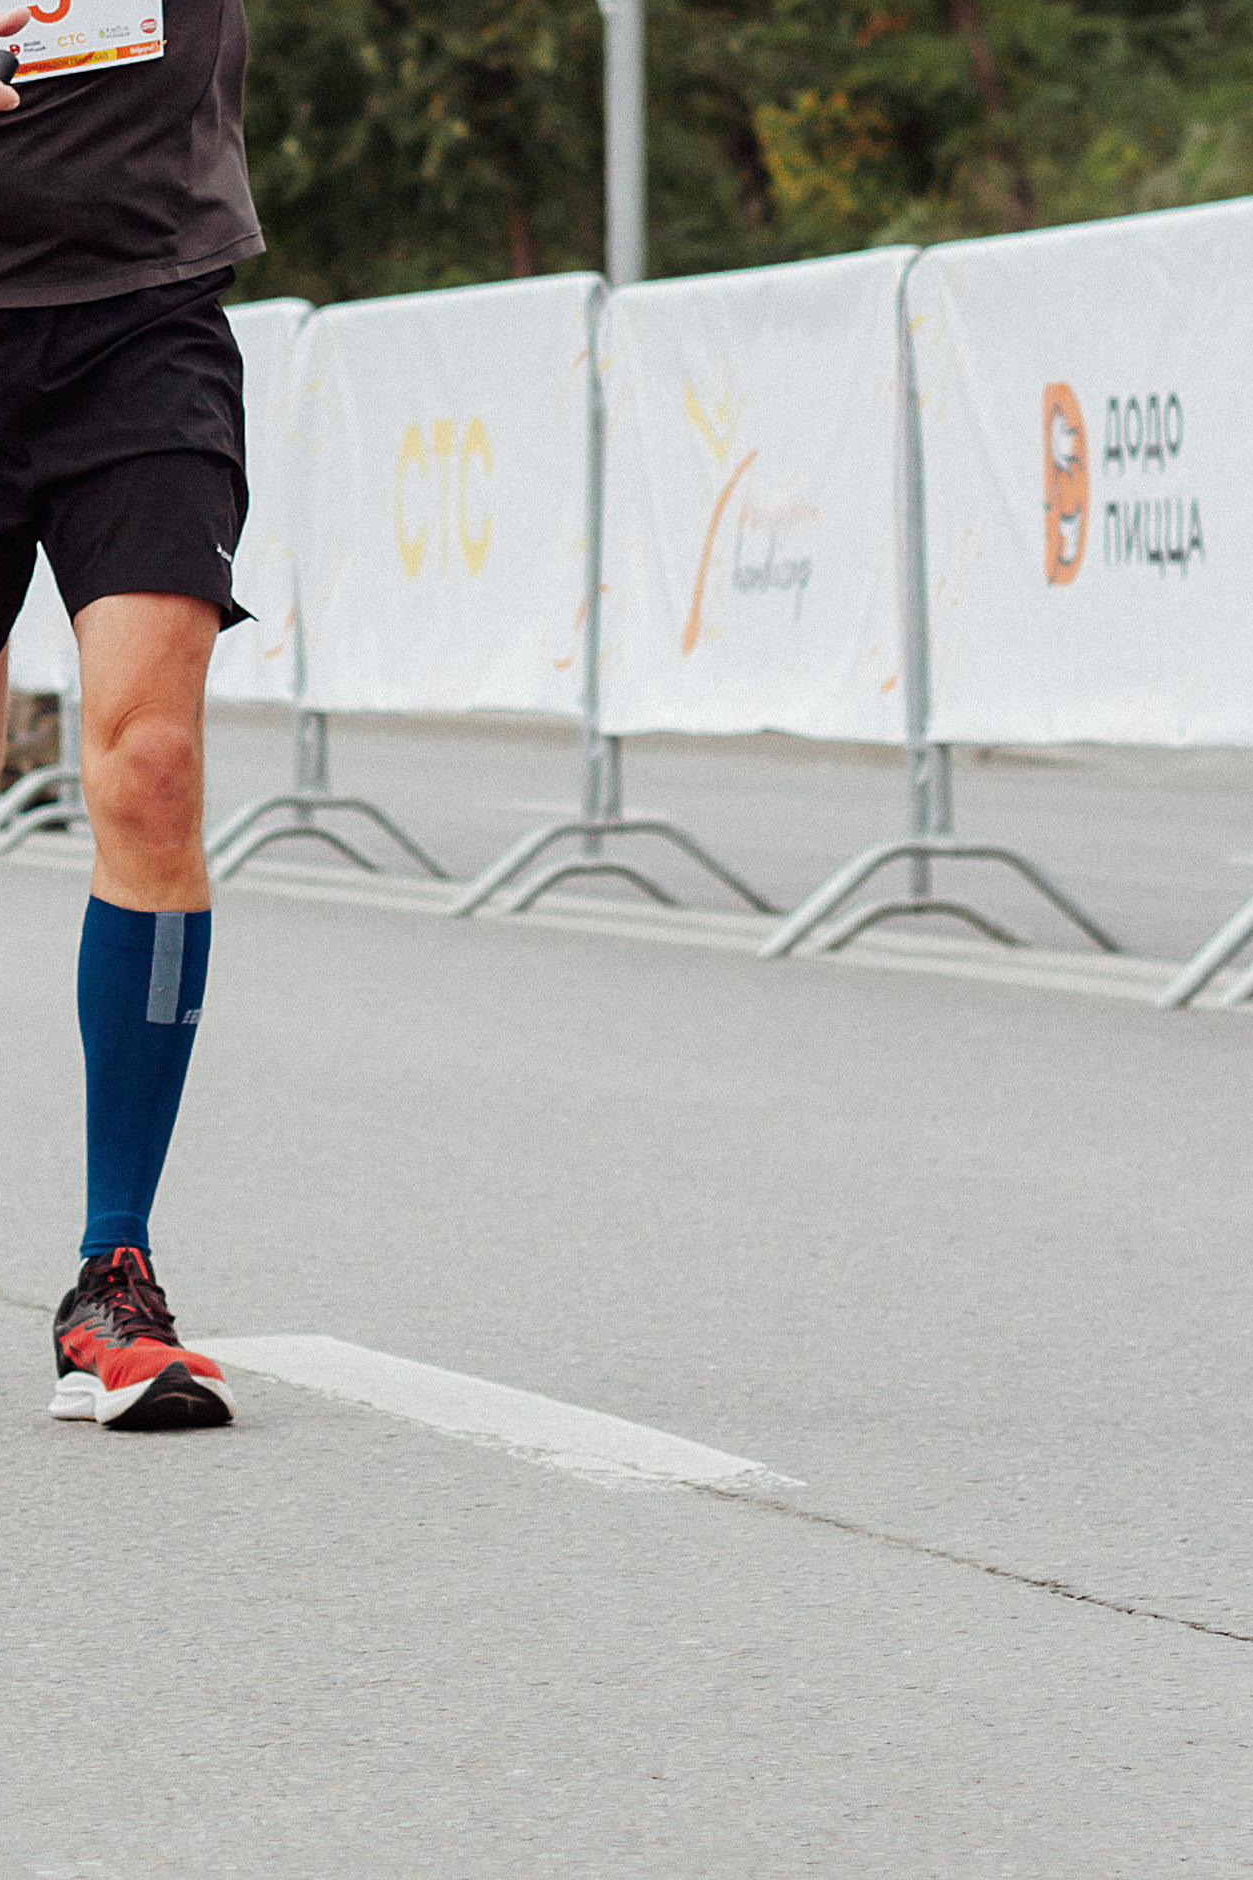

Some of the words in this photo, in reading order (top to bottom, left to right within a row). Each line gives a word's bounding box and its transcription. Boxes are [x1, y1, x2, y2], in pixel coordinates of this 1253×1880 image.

[57, 32, 88, 48] СТС
[1102, 390, 1185, 477] ДОДО
[395, 417, 495, 580] СТС
[1103, 496, 1206, 579] ПИЦЦА
